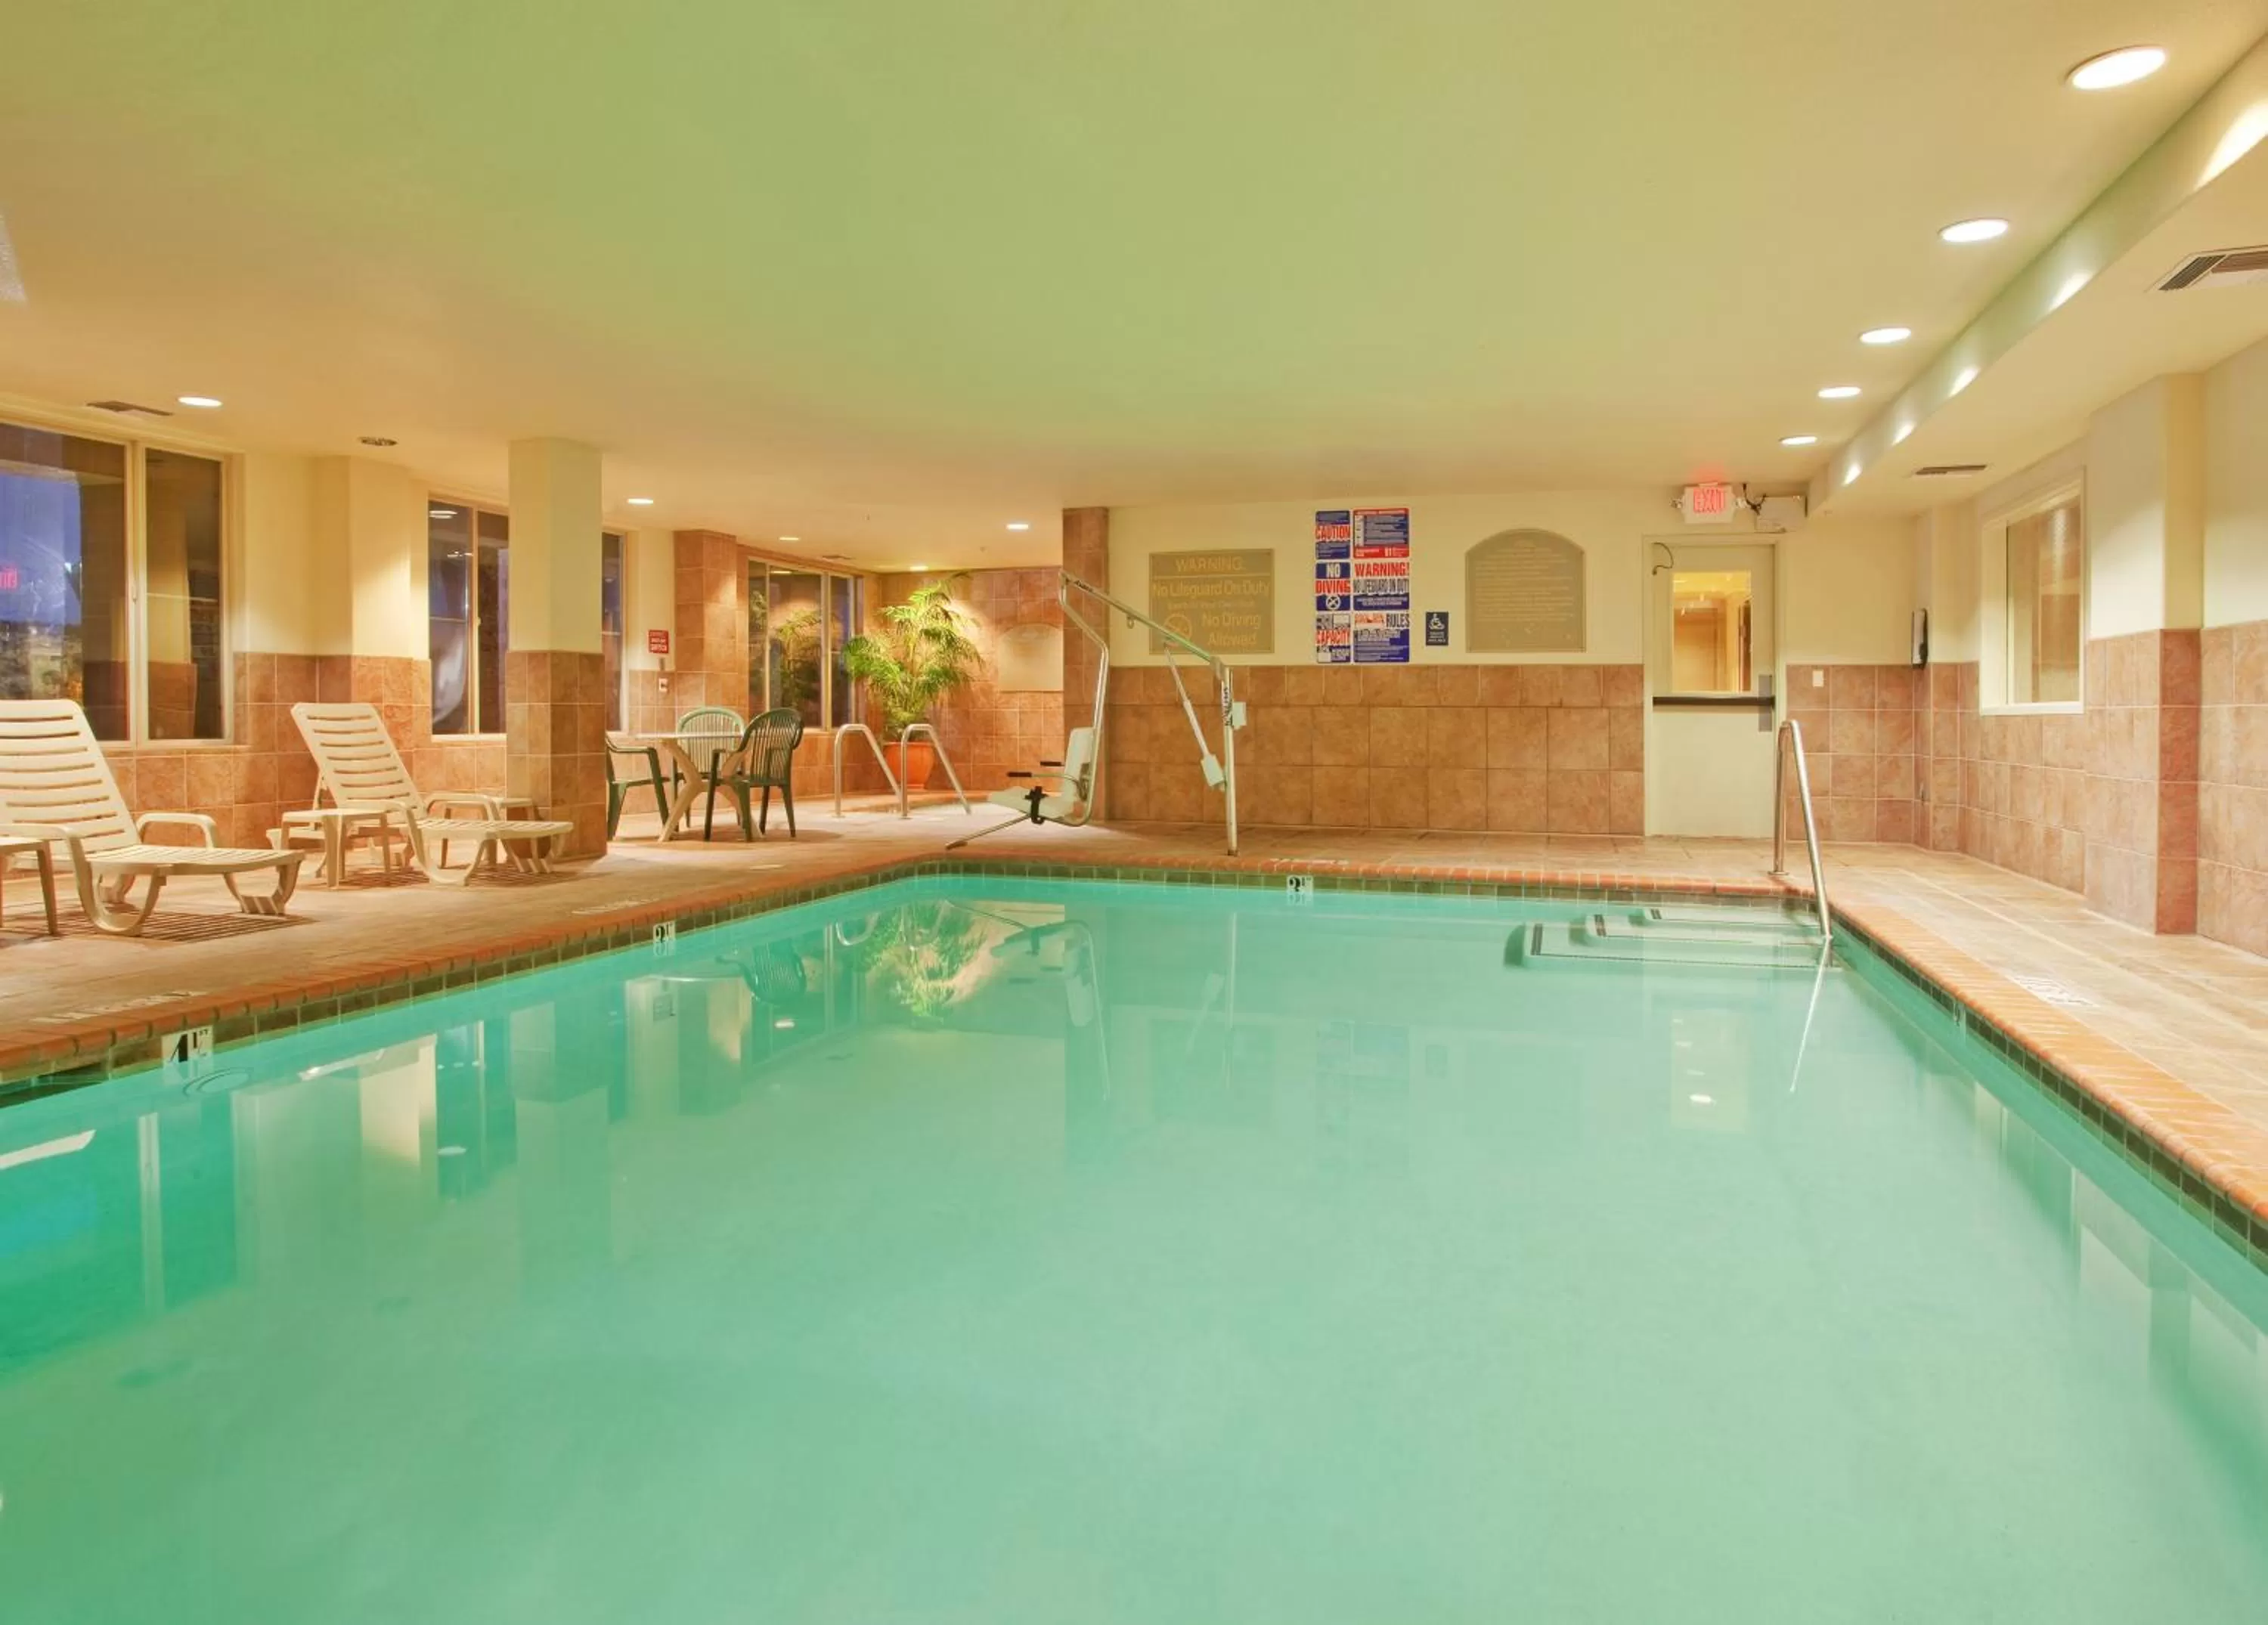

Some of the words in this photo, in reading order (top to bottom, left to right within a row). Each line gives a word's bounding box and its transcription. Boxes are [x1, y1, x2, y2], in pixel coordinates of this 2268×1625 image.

[1693, 488, 1724, 512] EXIT
[1316, 524, 1350, 541] CAUTION
[1327, 562, 1340, 577] NO
[1153, 580, 1169, 596] No
[1170, 580, 1222, 599] Lifeguard
[1224, 580, 1241, 595] On
[1243, 580, 1270, 596] Duty
[1316, 580, 1350, 593] DIVING
[1202, 611, 1219, 627] No
[1222, 611, 1261, 629] Diving
[1387, 613, 1409, 627] RULES
[1208, 632, 1256, 646] Allowed
